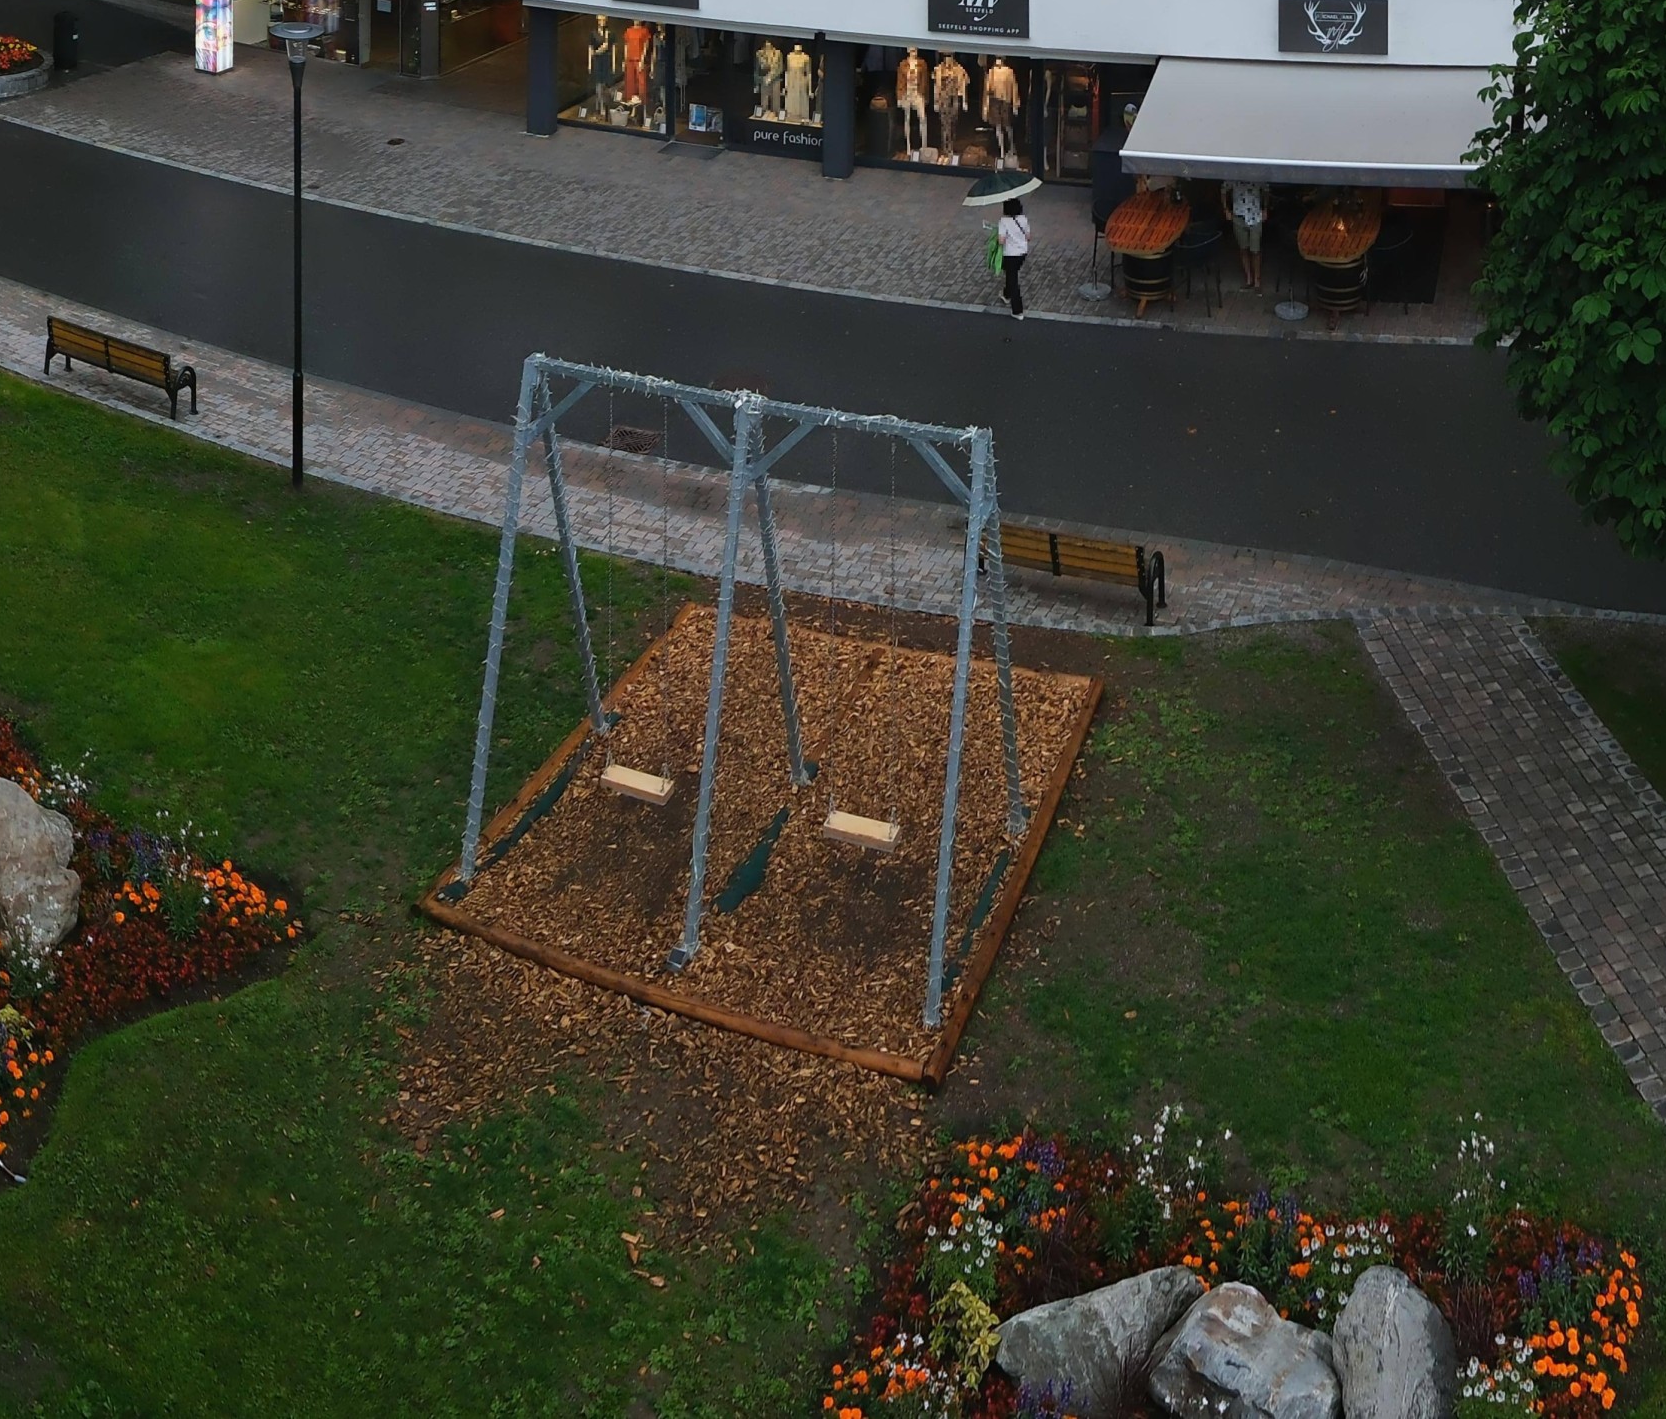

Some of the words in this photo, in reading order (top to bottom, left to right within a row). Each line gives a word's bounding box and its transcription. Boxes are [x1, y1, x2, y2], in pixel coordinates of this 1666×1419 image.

[965, 7, 994, 15] SEEFELD
[938, 23, 967, 31] SEEFELD
[969, 25, 1004, 33] SHOPPING
[753, 130, 779, 141] pure
